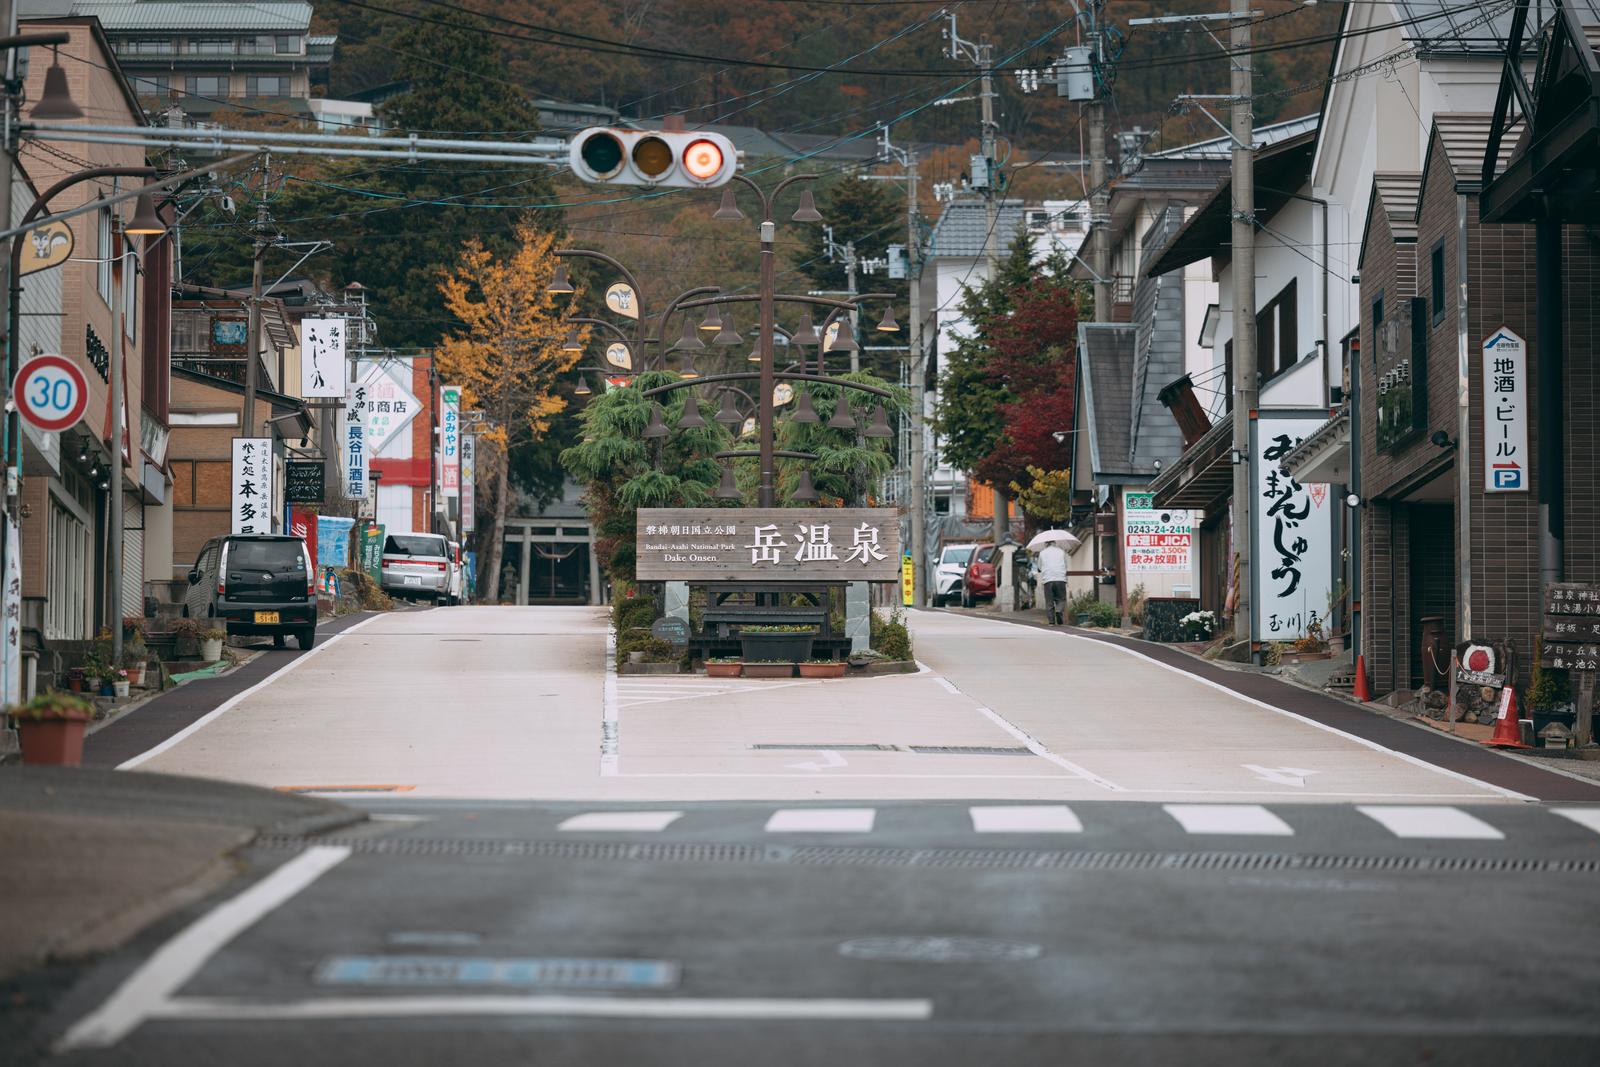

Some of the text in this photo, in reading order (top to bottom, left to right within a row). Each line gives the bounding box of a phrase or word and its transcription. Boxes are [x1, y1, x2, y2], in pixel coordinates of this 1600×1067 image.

[31, 376, 72, 411] 30
[1493, 358, 1516, 457] 地酒・ビール
[445, 411, 456, 456] おみやげ
[349, 426, 363, 496] 長谷川酒店
[1500, 471, 1517, 486] P
[1128, 497, 1153, 508] 恵美
[1263, 434, 1310, 598] みまんじゅう
[645, 525, 736, 535] 磐梯朝日国立公園
[1128, 525, 1191, 534] 0243-24-2414
[744, 522, 888, 565] 岳温泉
[1160, 535, 1190, 546] JICA
[664, 554, 717, 562] Dake Onsen
[1553, 590, 1600, 601] 温泉神社
[1269, 611, 1323, 635] 玉川屋
